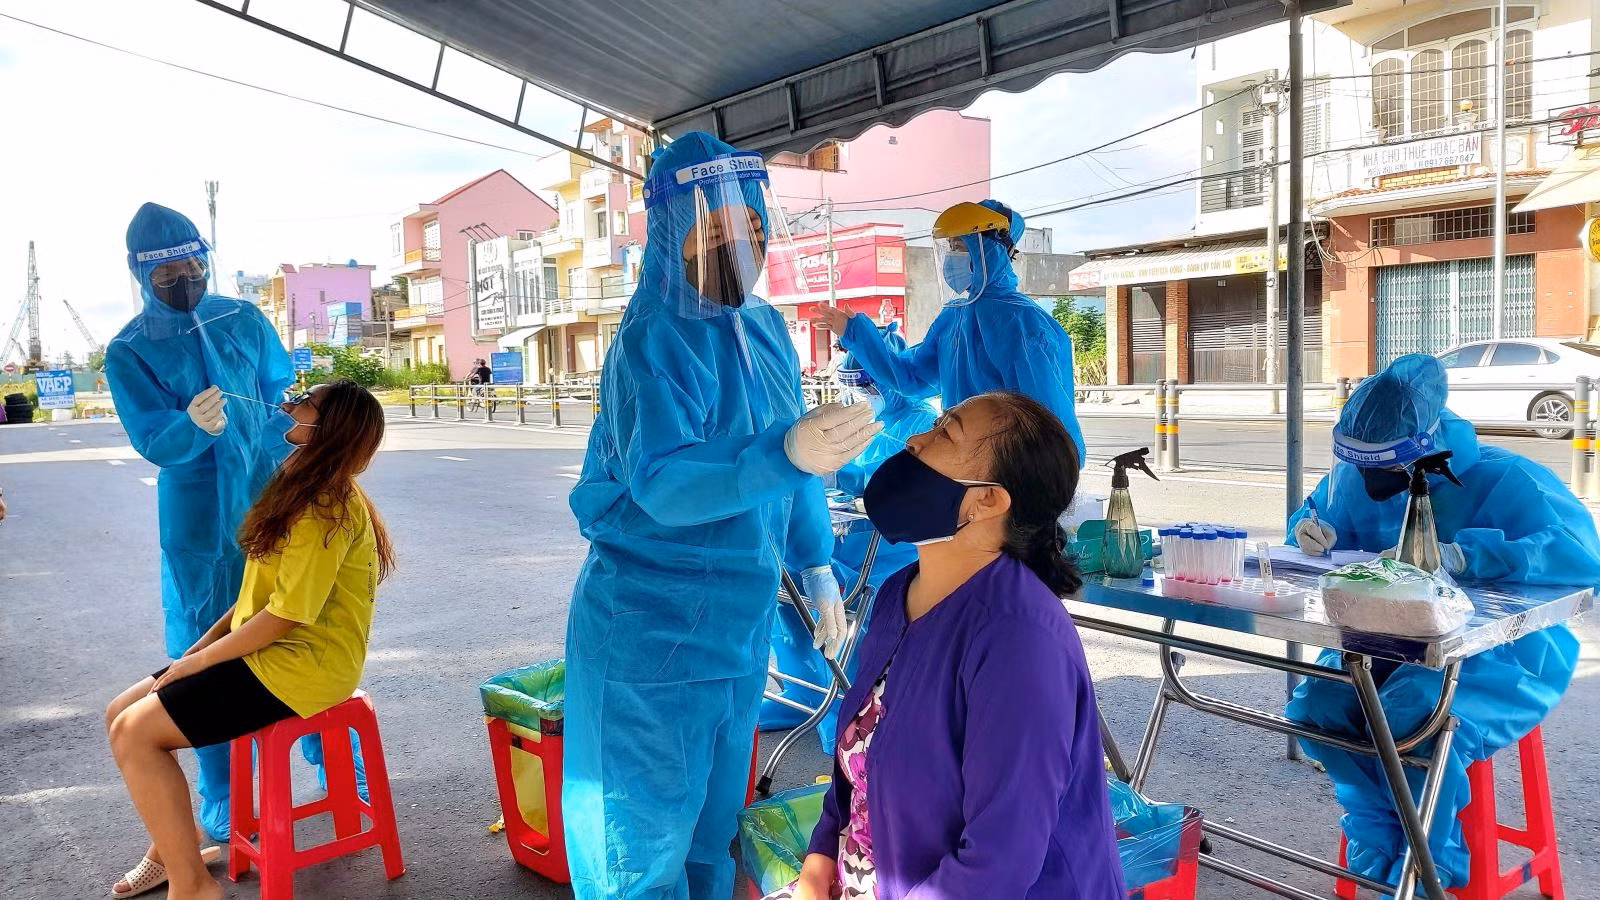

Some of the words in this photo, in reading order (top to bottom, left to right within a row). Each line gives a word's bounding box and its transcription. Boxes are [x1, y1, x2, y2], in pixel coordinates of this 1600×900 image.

[691, 164, 724, 178] Face
[729, 159, 760, 170] Shield
[144, 252, 163, 260] Face
[167, 244, 193, 257] Shield
[1347, 450, 1380, 461] Shield
